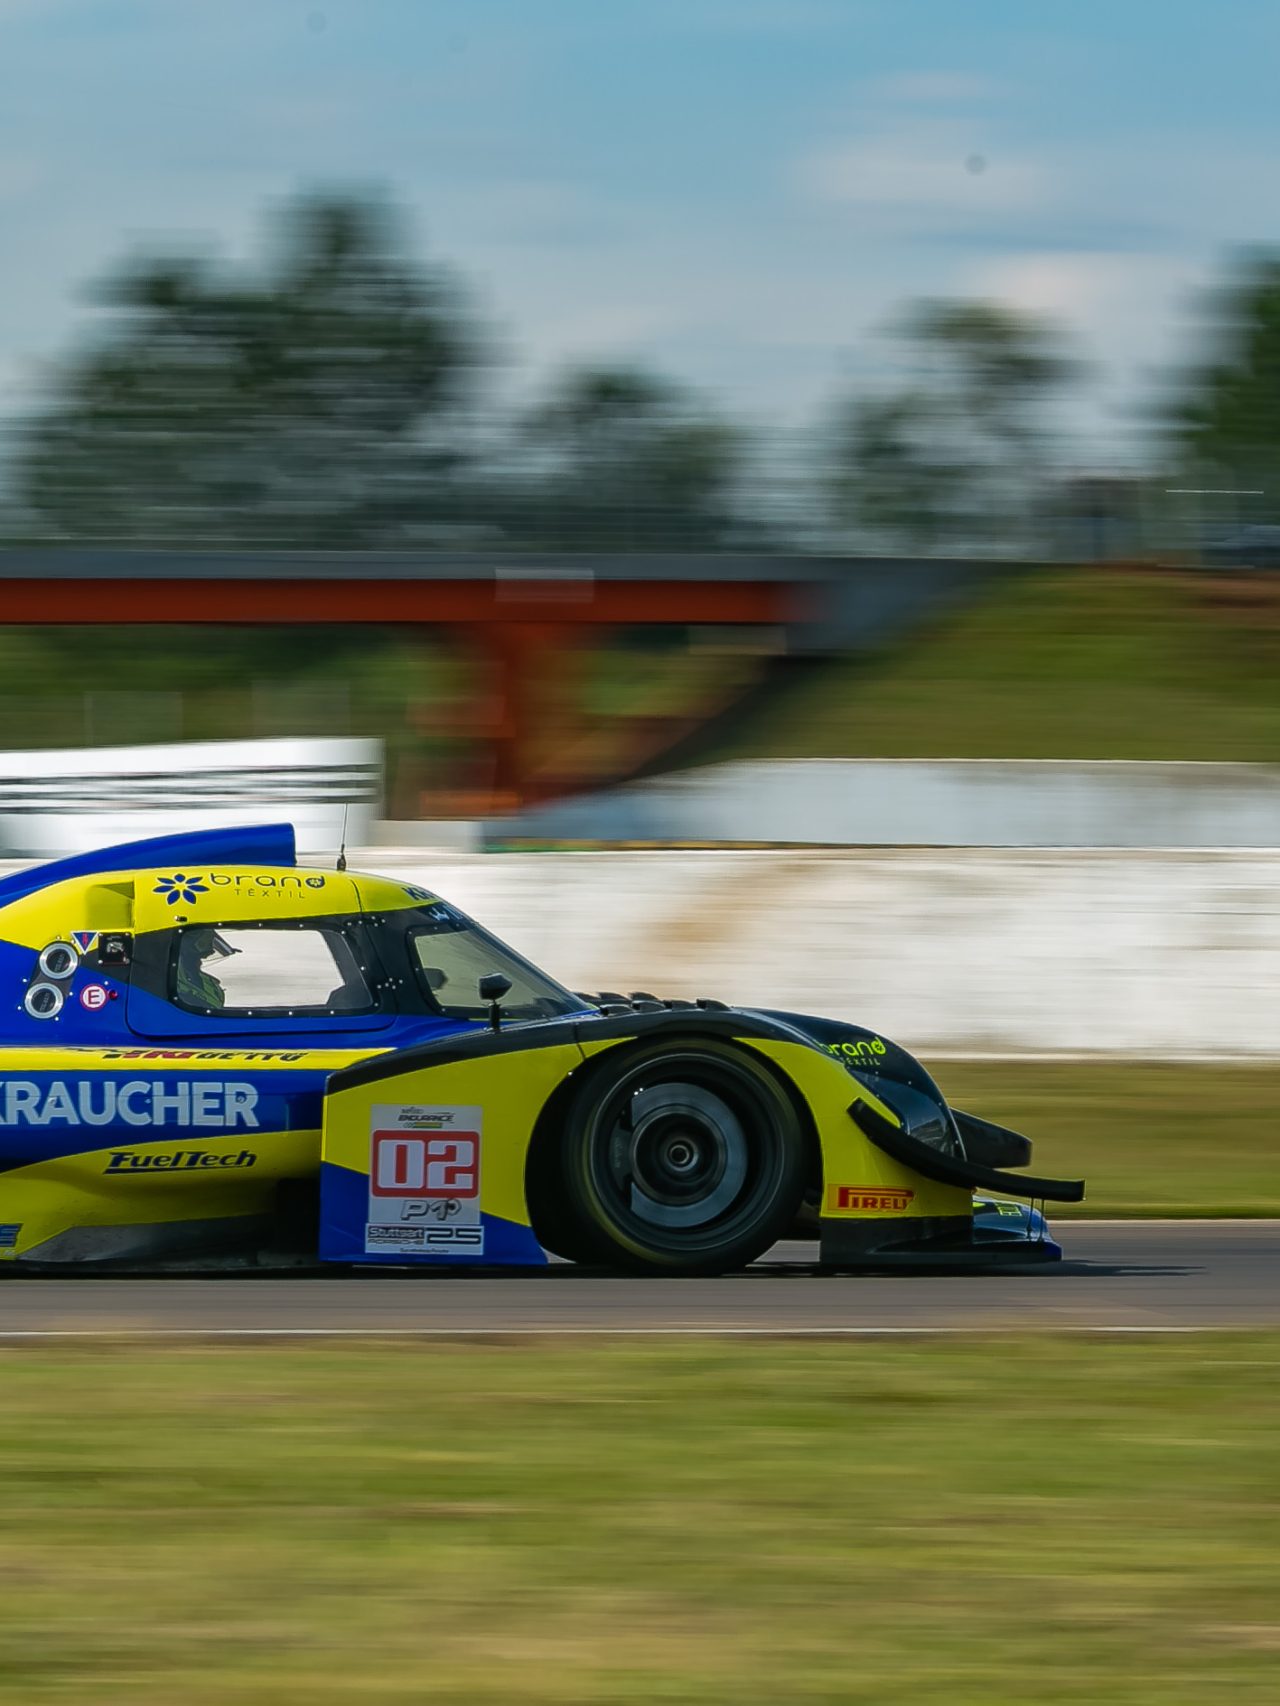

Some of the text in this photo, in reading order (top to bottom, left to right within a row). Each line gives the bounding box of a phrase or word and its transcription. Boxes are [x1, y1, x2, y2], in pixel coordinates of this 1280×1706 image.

[209, 872, 326, 890] brand
[87, 989, 101, 1005] E
[106, 1150, 258, 1170] FuelTech
[378, 1140, 474, 1190] 02
[425, 1227, 482, 1245] 25
